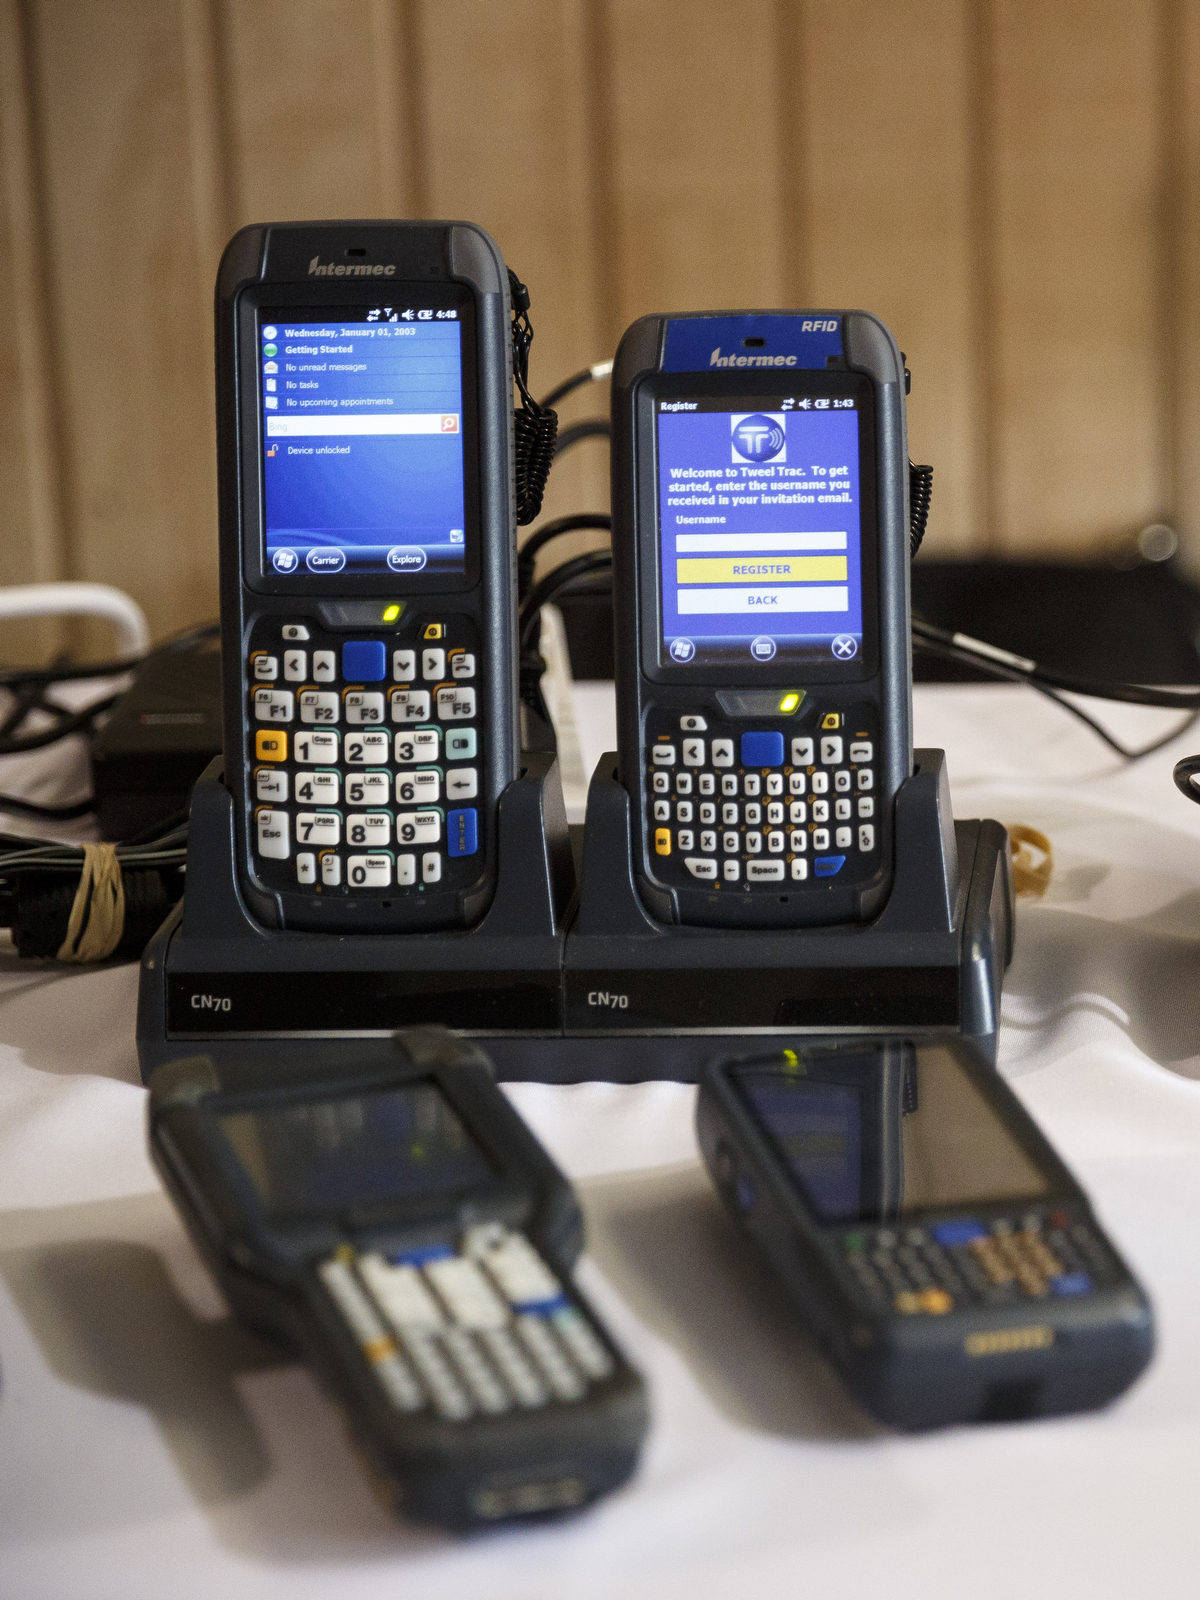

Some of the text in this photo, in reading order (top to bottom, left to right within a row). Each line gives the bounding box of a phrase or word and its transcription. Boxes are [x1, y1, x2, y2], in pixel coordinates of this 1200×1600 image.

[308, 255, 396, 276] Intermec
[436, 310, 457, 319] 4:48
[802, 320, 838, 332] RFID
[285, 327, 416, 339] Wednesday, January 01, 2003
[285, 345, 353, 356] Getting Started
[710, 347, 797, 367] Intermec
[286, 363, 367, 372] No unread messages
[286, 381, 319, 389] No tasks
[286, 397, 393, 408] No upcoming appointments
[661, 402, 697, 411] Register
[833, 399, 854, 408] 1:43
[287, 446, 350, 455] Device unlocked
[671, 465, 848, 478] Welcome to Tweel Trac. To get
[669, 480, 850, 493] started, enter the username you
[668, 493, 852, 506] received in your invitation email.
[676, 515, 726, 524] Username
[312, 555, 340, 565] Carrier
[392, 554, 421, 564] Explore
[733, 565, 791, 575] REGISTER
[748, 596, 778, 605] BACK
[270, 706, 287, 717] F1
[406, 706, 424, 717] F4
[452, 703, 471, 715] F5
[315, 708, 333, 720] F2
[361, 708, 379, 720] F3
[299, 742, 308, 760] 1
[349, 743, 363, 761] 2
[399, 742, 414, 760] 3
[656, 778, 665, 787] Q
[678, 780, 687, 788] W
[818, 779, 821, 787] I
[839, 778, 846, 786] O
[861, 776, 868, 784] P
[703, 781, 710, 789] E
[726, 781, 733, 790] R
[748, 781, 755, 790] T
[771, 781, 778, 790] Y
[793, 781, 800, 789] U
[299, 782, 313, 800] 4
[350, 783, 364, 801] 5
[400, 783, 414, 800] 6
[658, 807, 665, 815] A
[680, 808, 687, 817] S
[703, 809, 711, 818] D
[726, 810, 733, 818] F
[748, 810, 756, 819] G
[771, 809, 779, 818] H
[795, 809, 801, 817] J
[816, 807, 824, 816] K
[840, 806, 846, 815] L
[262, 830, 281, 838] Esc
[301, 823, 314, 840] 7
[351, 825, 366, 842] 8
[401, 824, 416, 841] 9
[682, 836, 689, 845] Z
[704, 837, 712, 846] X
[726, 838, 734, 847] C
[749, 838, 757, 847] V
[772, 838, 779, 846] B
[794, 837, 802, 845] N
[816, 835, 825, 844] M
[352, 866, 366, 884] 0
[191, 995, 231, 1012] CN70
[588, 992, 628, 1008] CN70
